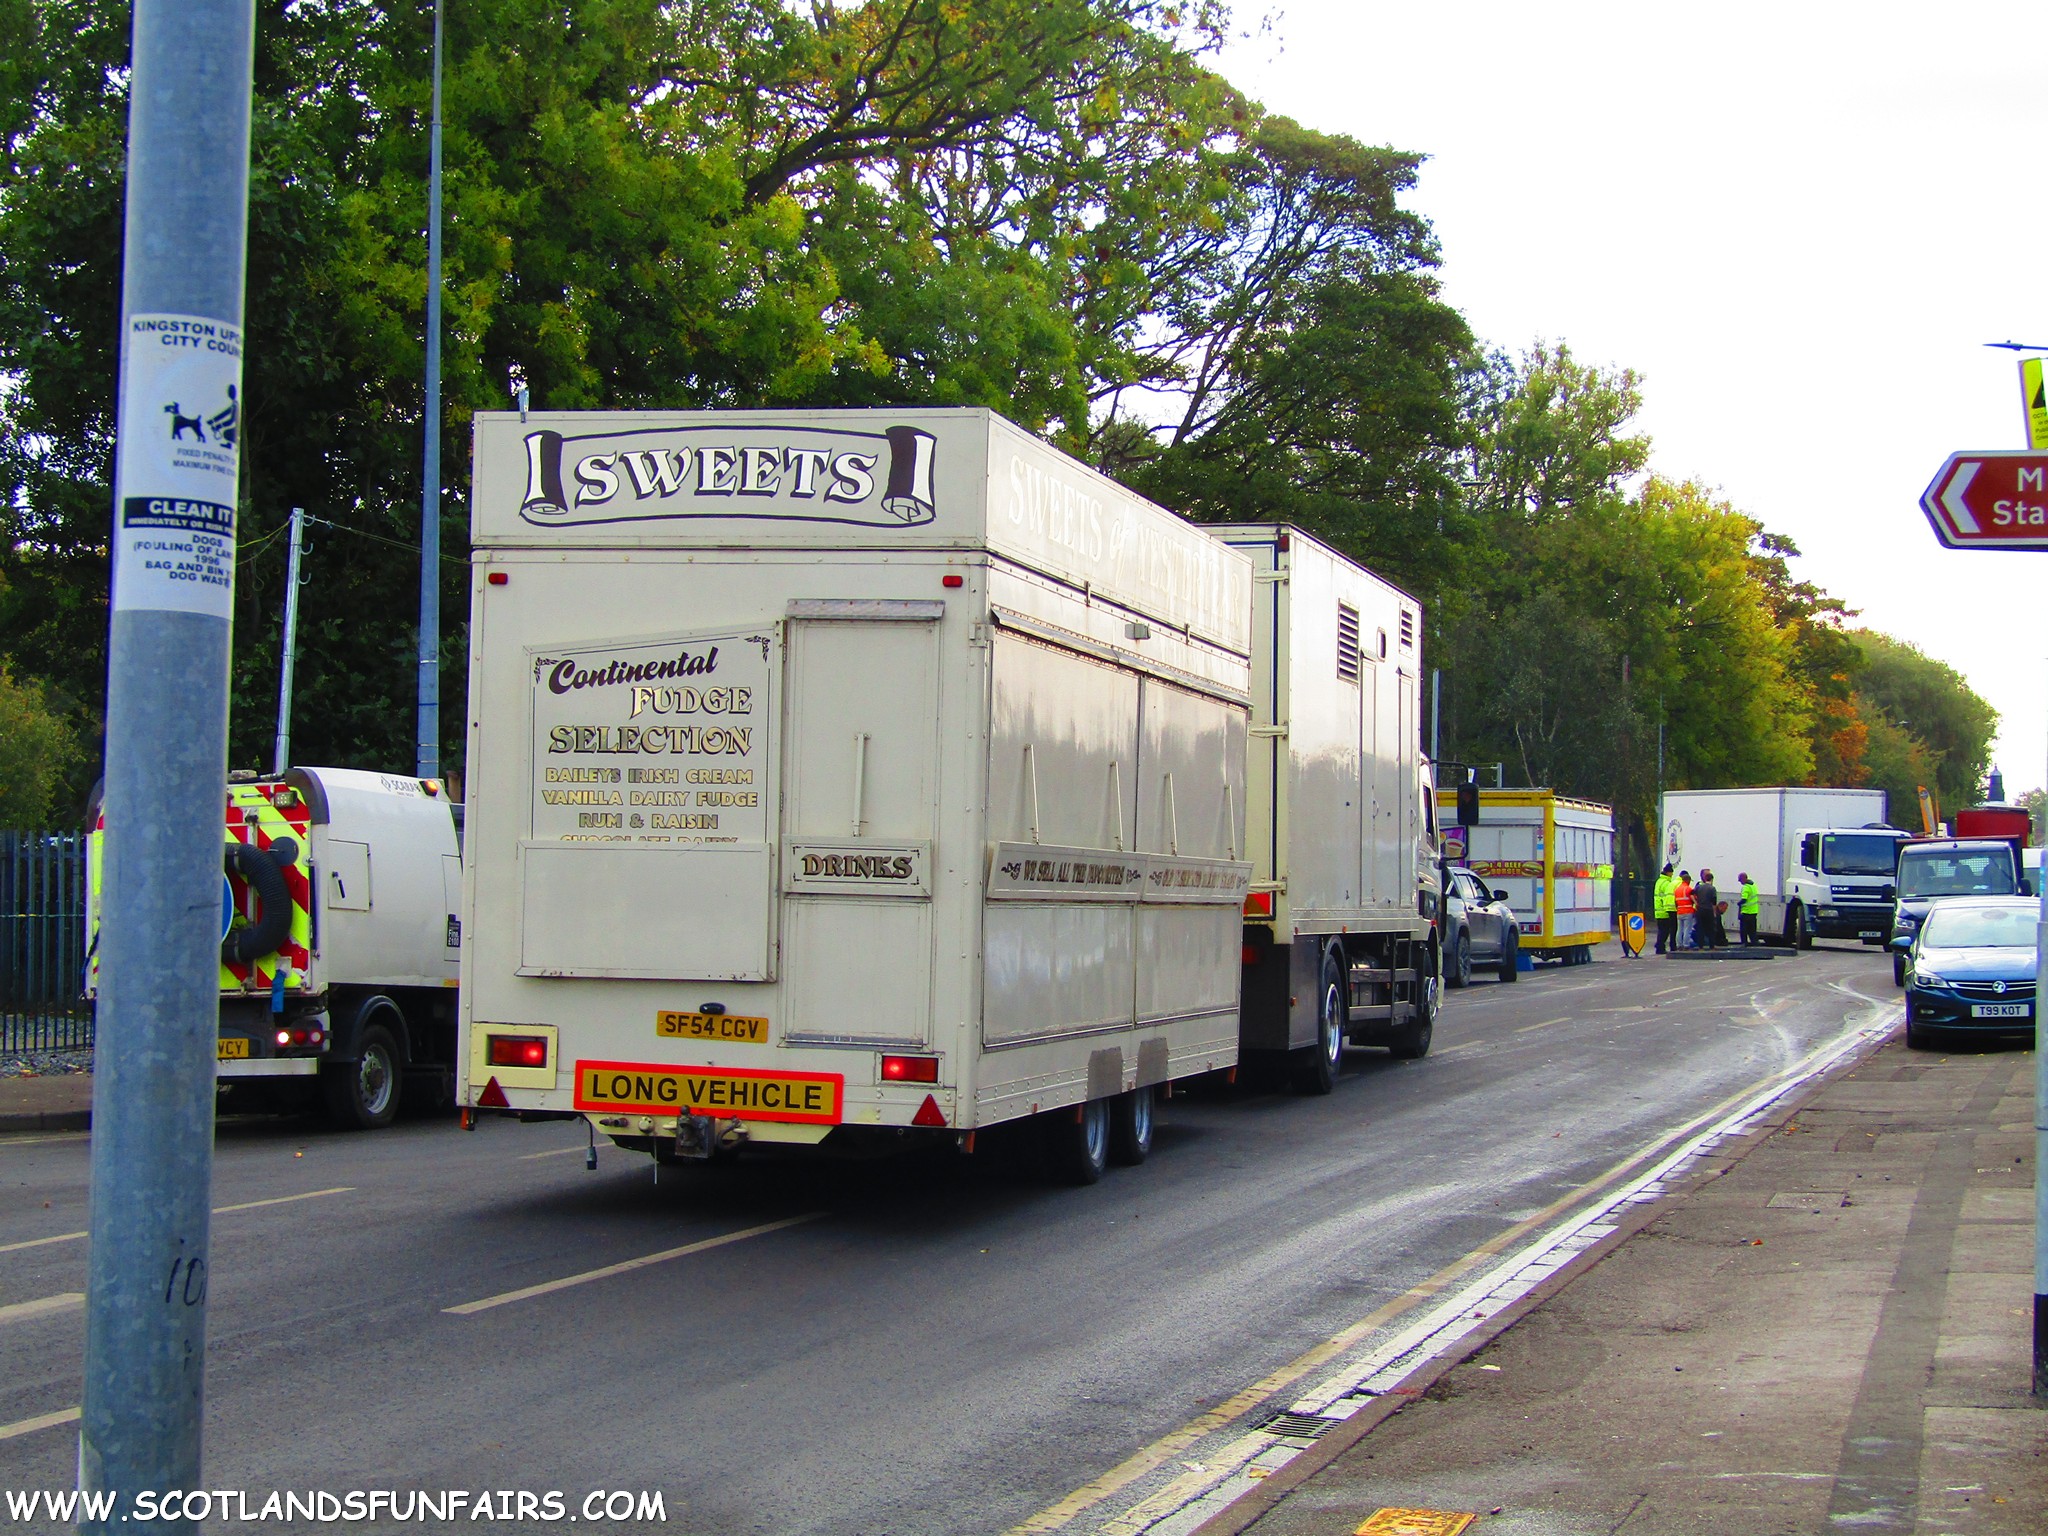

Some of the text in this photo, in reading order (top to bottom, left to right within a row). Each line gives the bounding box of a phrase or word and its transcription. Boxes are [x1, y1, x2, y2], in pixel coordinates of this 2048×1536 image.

[133, 320, 216, 336] KINGSTON
[161, 334, 201, 347] CITY
[177, 448, 201, 457] FIXED
[173, 460, 211, 470] MAXIMUM
[574, 445, 879, 508] SWEETS
[149, 500, 231, 522] CLEAN IT
[1008, 454, 1102, 563] SWEETS
[1992, 500, 2045, 525] Sta
[128, 517, 188, 526] IMMEDIATELY
[190, 520, 204, 528] OR
[192, 534, 223, 547] DOGS
[197, 545, 213, 555] OF
[145, 561, 172, 570] BAG
[177, 562, 203, 572] AND
[207, 565, 224, 575] BIN
[194, 555, 220, 566] 1996
[169, 571, 197, 581] DOG
[549, 646, 719, 694] Continental
[630, 686, 753, 719] FUDGE
[548, 725, 753, 756] SELECTION
[546, 768, 753, 784] BAILEYS IRISH CREAM
[542, 790, 758, 807] VANILLA DAIRY FUDGE
[579, 813, 718, 829] RUM & RAISIN
[801, 854, 913, 879] DRINKS
[1979, 1006, 2021, 1015] T99 KOT
[665, 1014, 760, 1039] SF54 CGV
[592, 1074, 822, 1110] LONG VEHICLE
